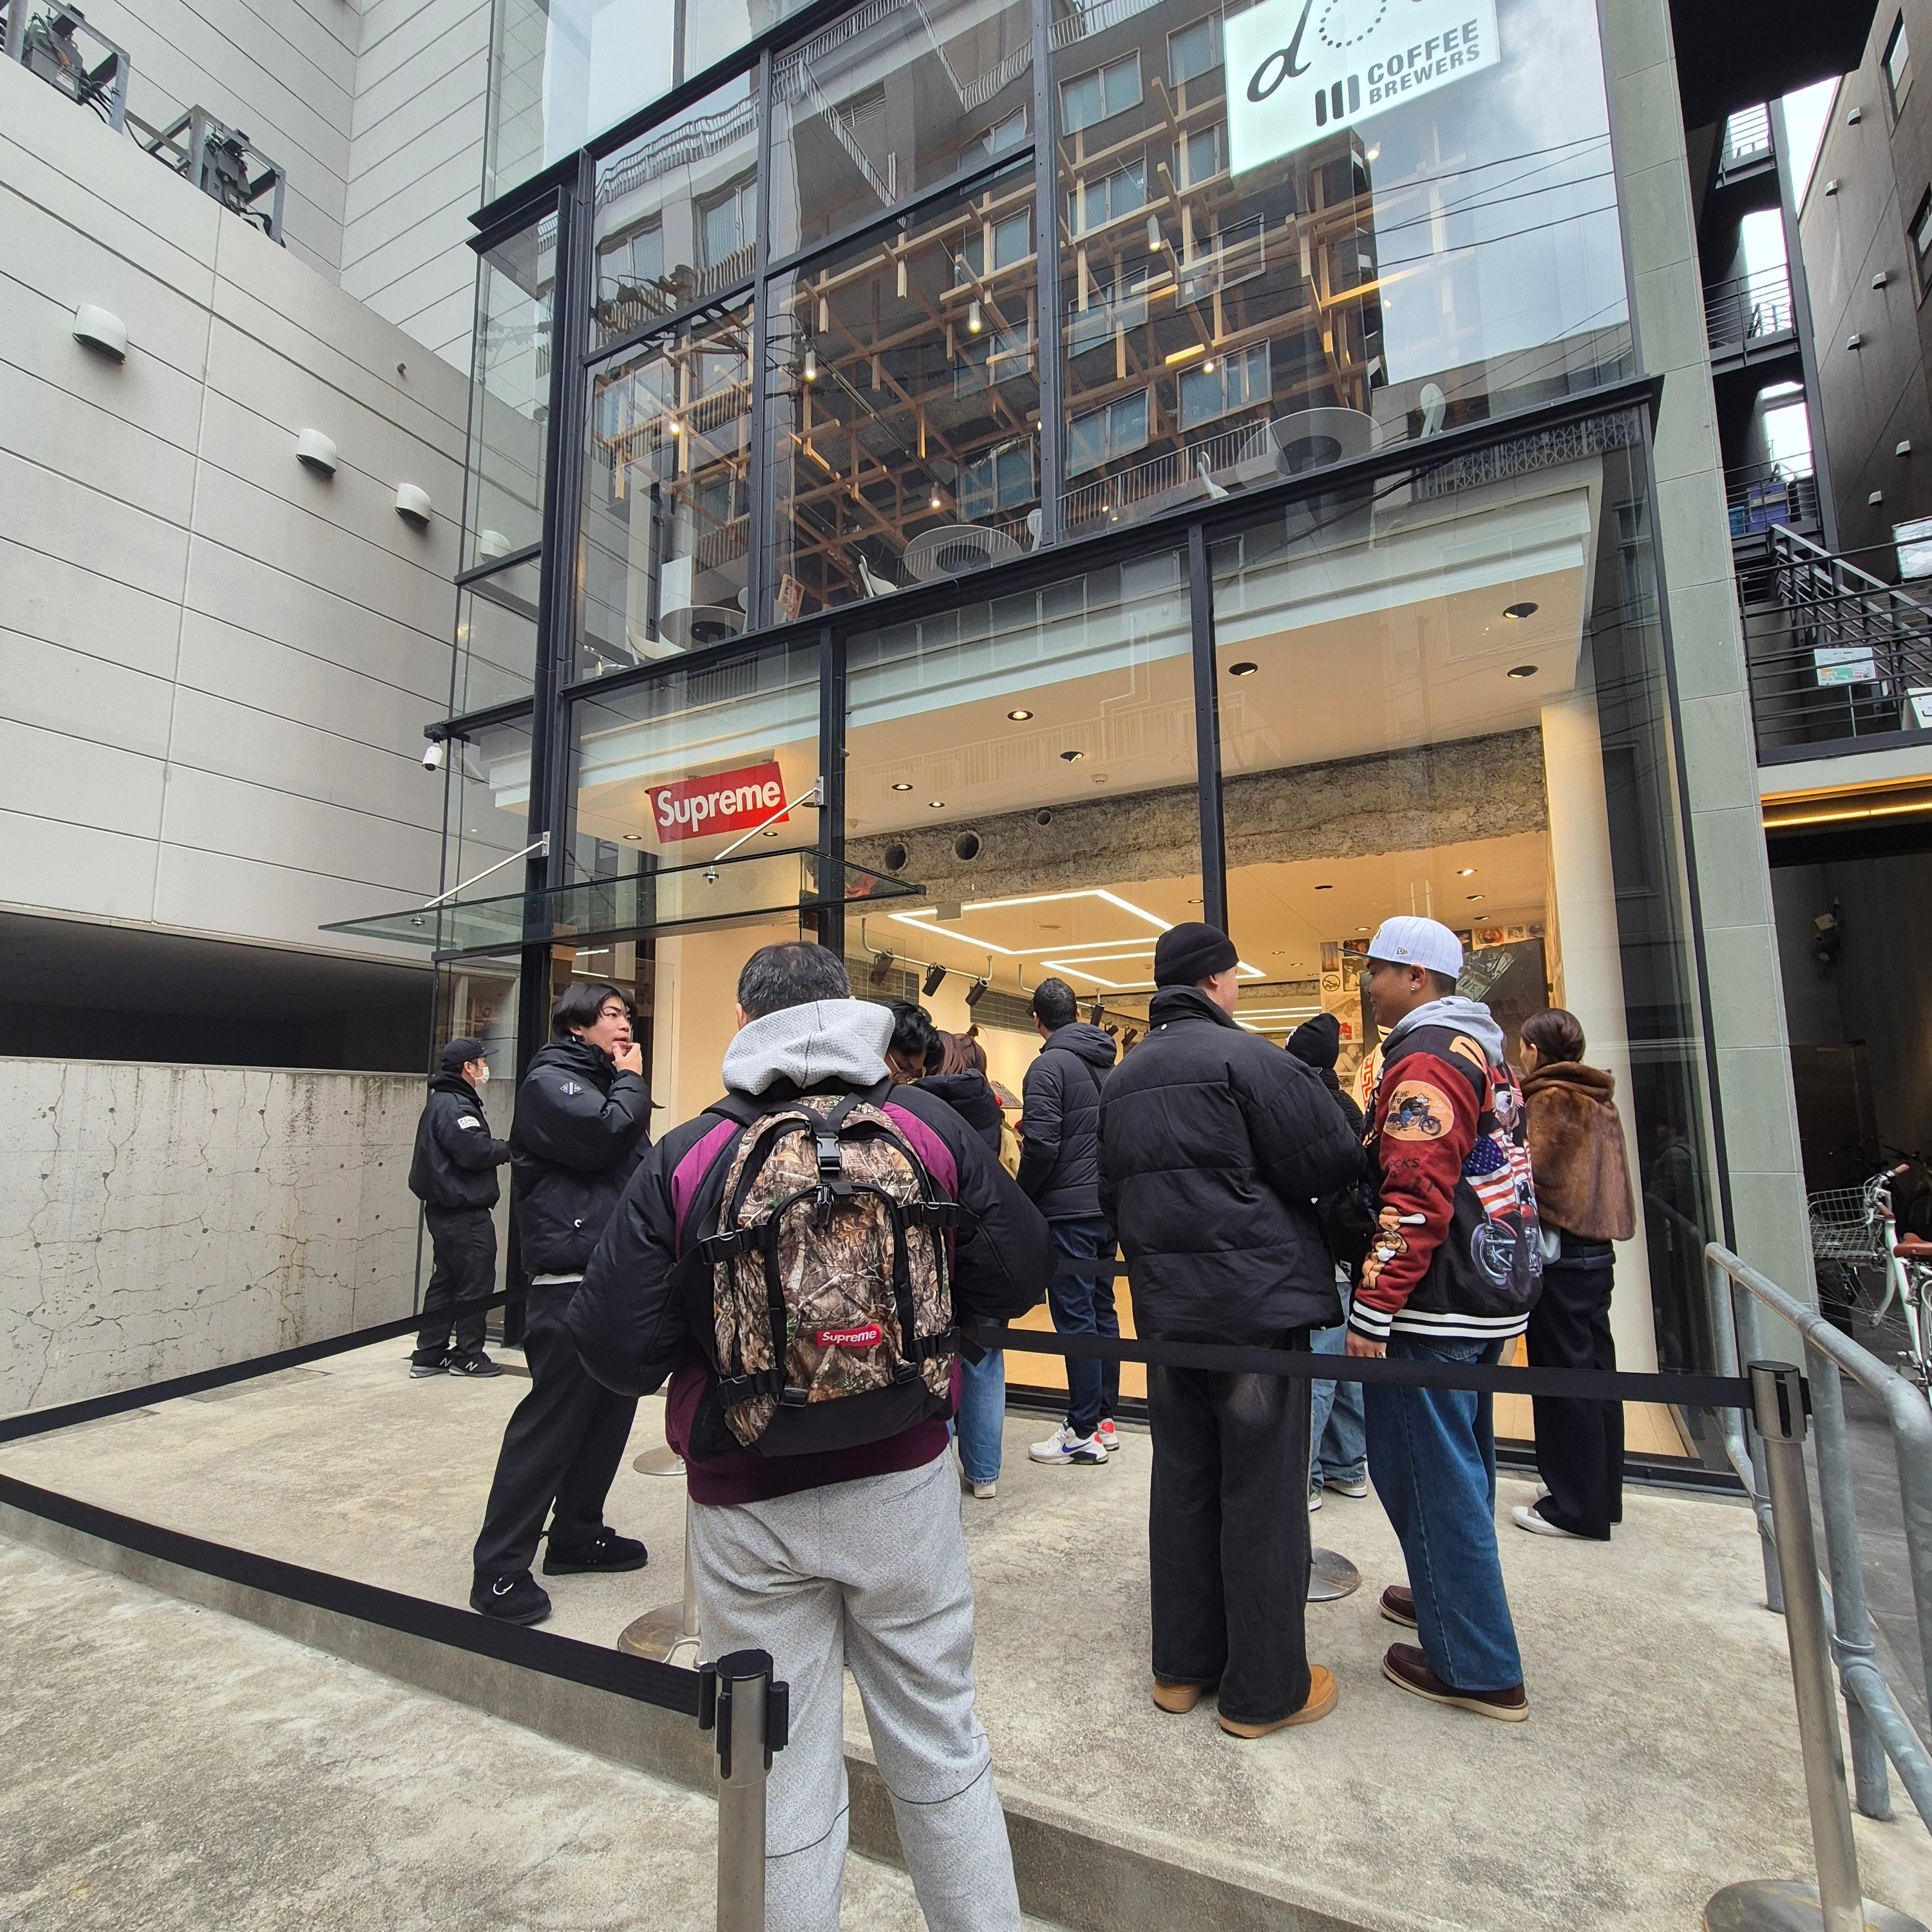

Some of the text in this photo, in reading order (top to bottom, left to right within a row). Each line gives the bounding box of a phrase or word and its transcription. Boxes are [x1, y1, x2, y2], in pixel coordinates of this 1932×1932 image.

[1367, 18, 1479, 86] COFFEE
[1369, 43, 1480, 105] BREWERS
[658, 780, 781, 832] Supreme
[821, 1330, 877, 1344] Supreme
[439, 1357, 451, 1367] N
[464, 1361, 478, 1371] N
